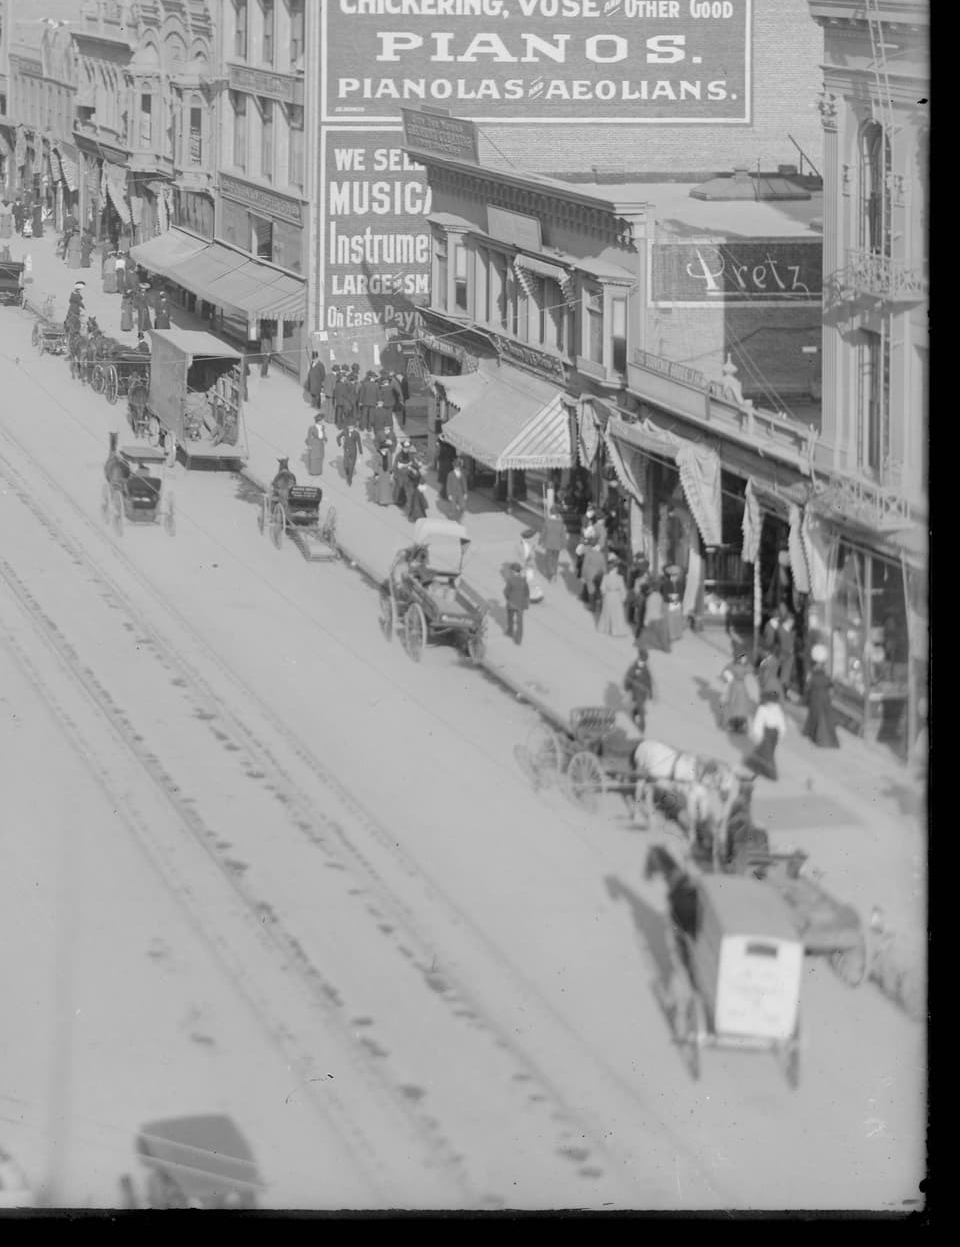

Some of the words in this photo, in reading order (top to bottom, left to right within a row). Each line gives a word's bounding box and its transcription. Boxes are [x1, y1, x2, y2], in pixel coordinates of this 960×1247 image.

[376, 31, 702, 64] PIANOS.
[338, 78, 524, 99] PIANOLAS
[544, 80, 738, 101] AEOLIANS.
[334, 149, 366, 171] WE
[330, 221, 431, 265] Instrume
[332, 274, 393, 295] LARGE
[327, 306, 343, 328] On
[346, 305, 383, 331] Easy
